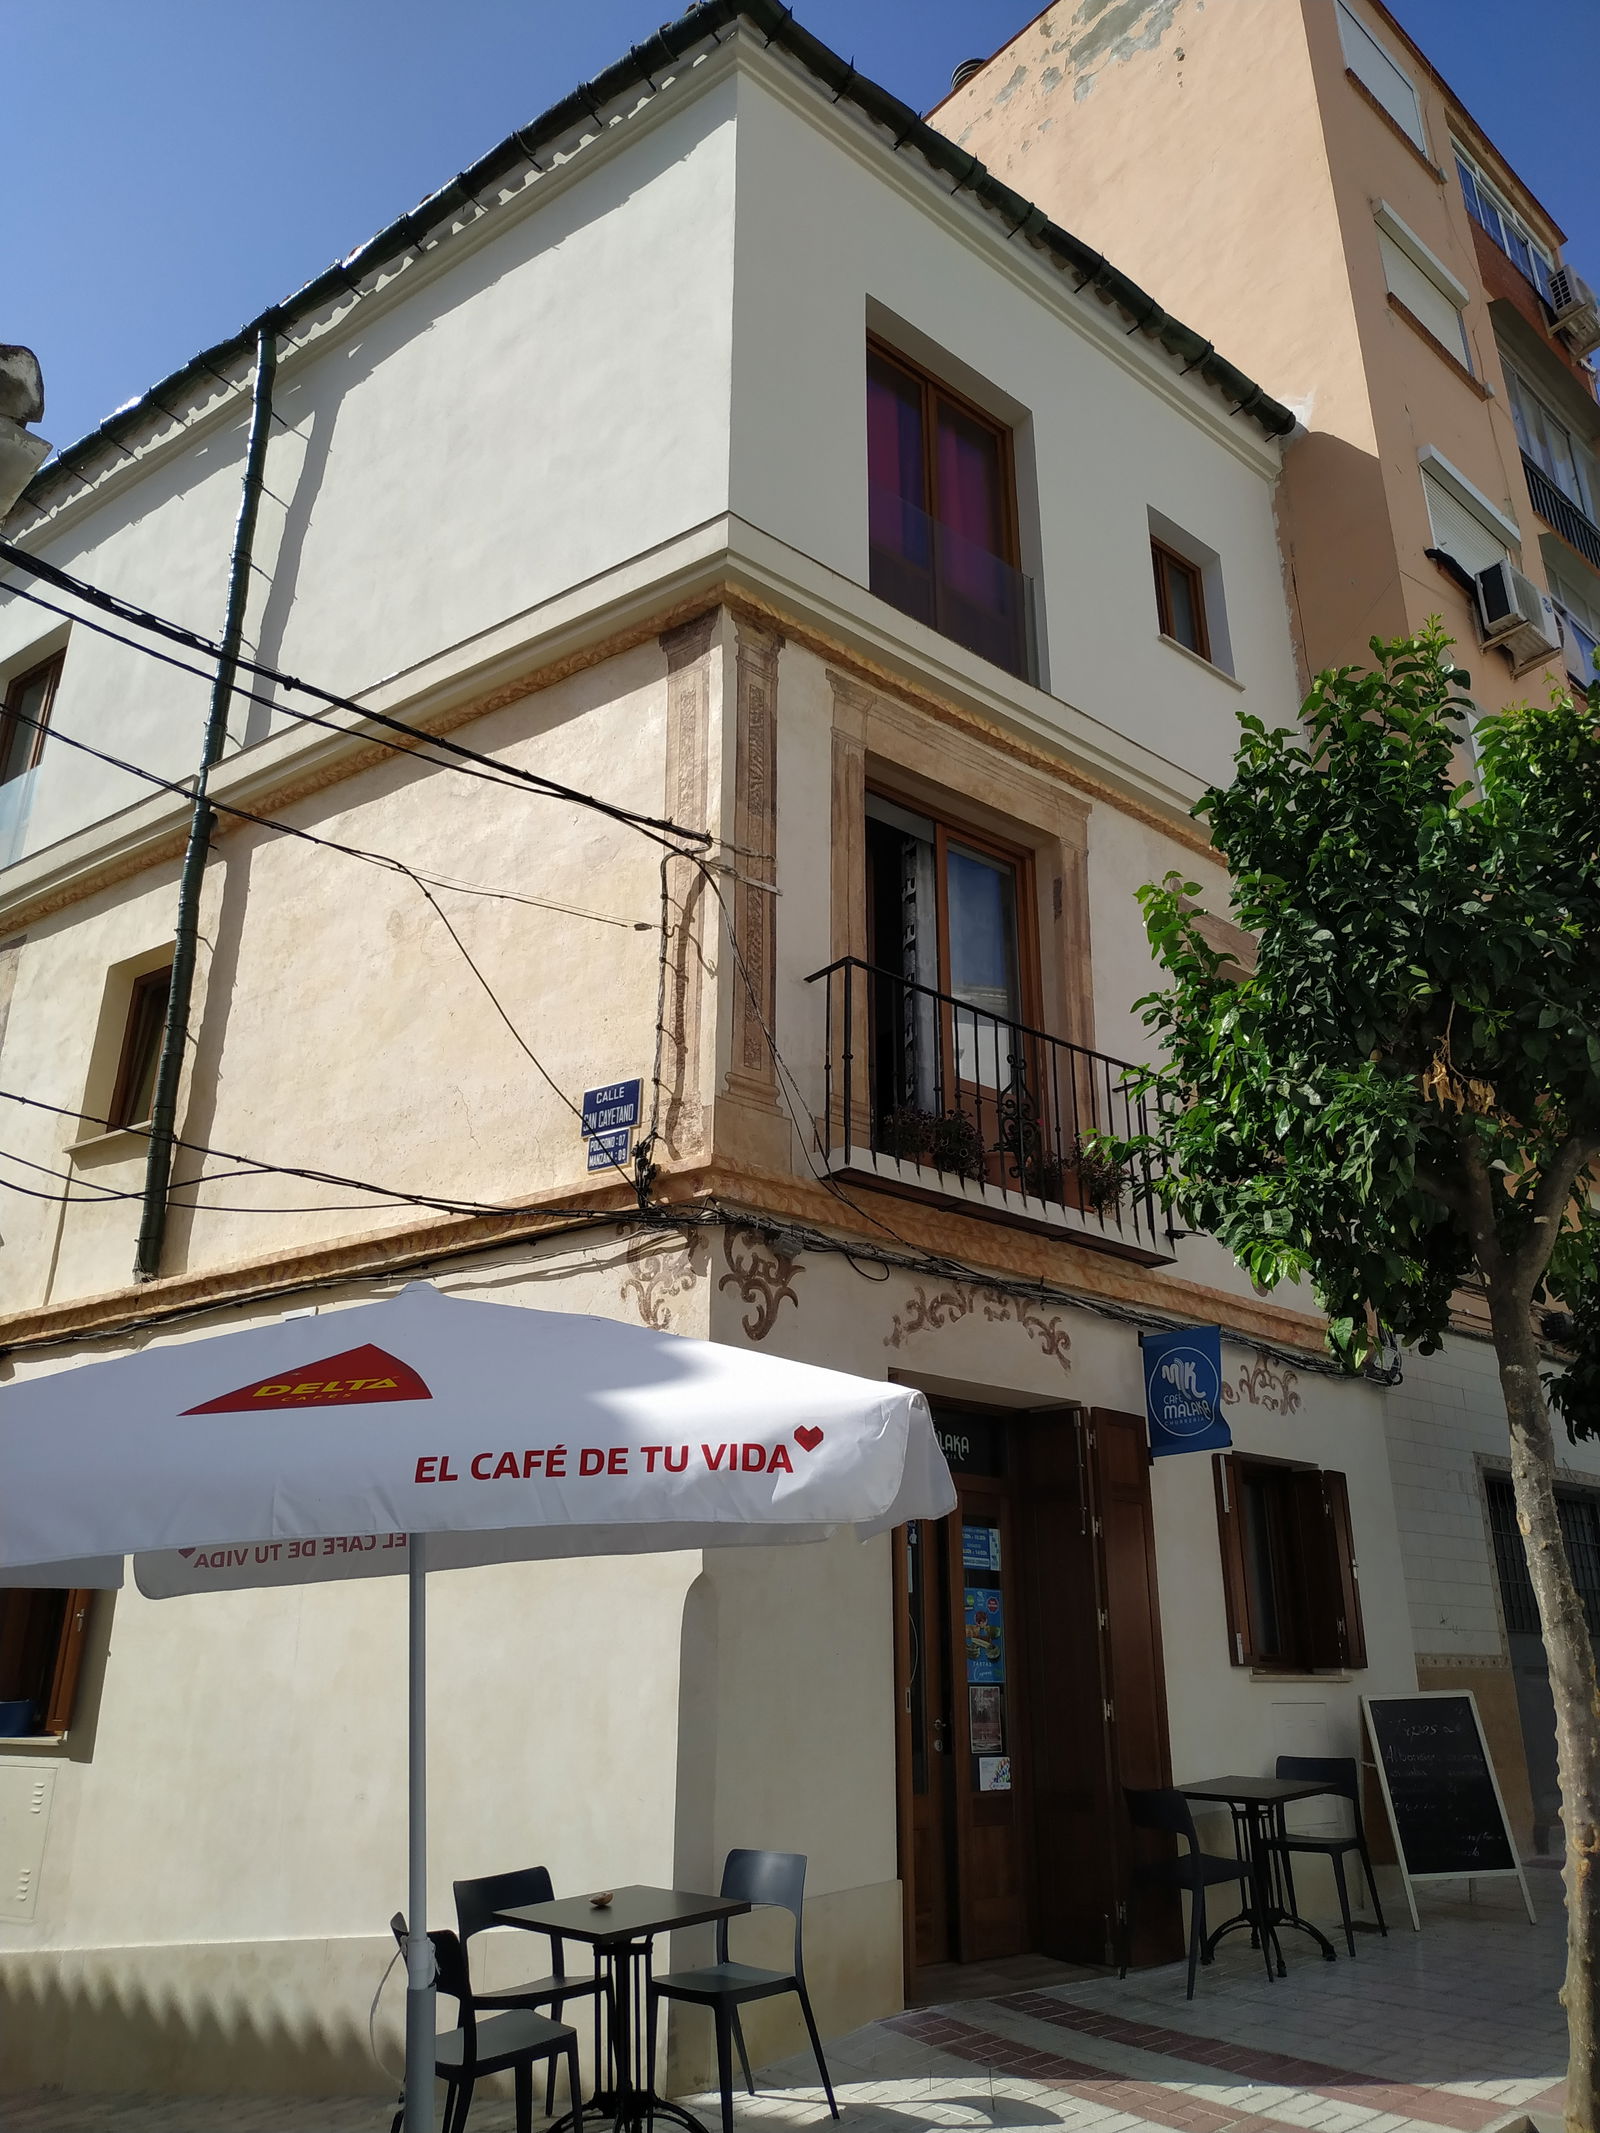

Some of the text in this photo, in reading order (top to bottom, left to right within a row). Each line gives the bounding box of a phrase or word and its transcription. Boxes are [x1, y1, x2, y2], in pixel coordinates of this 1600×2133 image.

[596, 1086, 625, 1104] CALLE
[583, 1104, 634, 1131] SAN CAYETANO
[252, 1378, 399, 1398] DELTA
[1164, 1400, 1211, 1420] MALAKA
[935, 1430, 970, 1461] LAKA
[415, 1443, 794, 1483] EL CAFÉ DE TU VIDA
